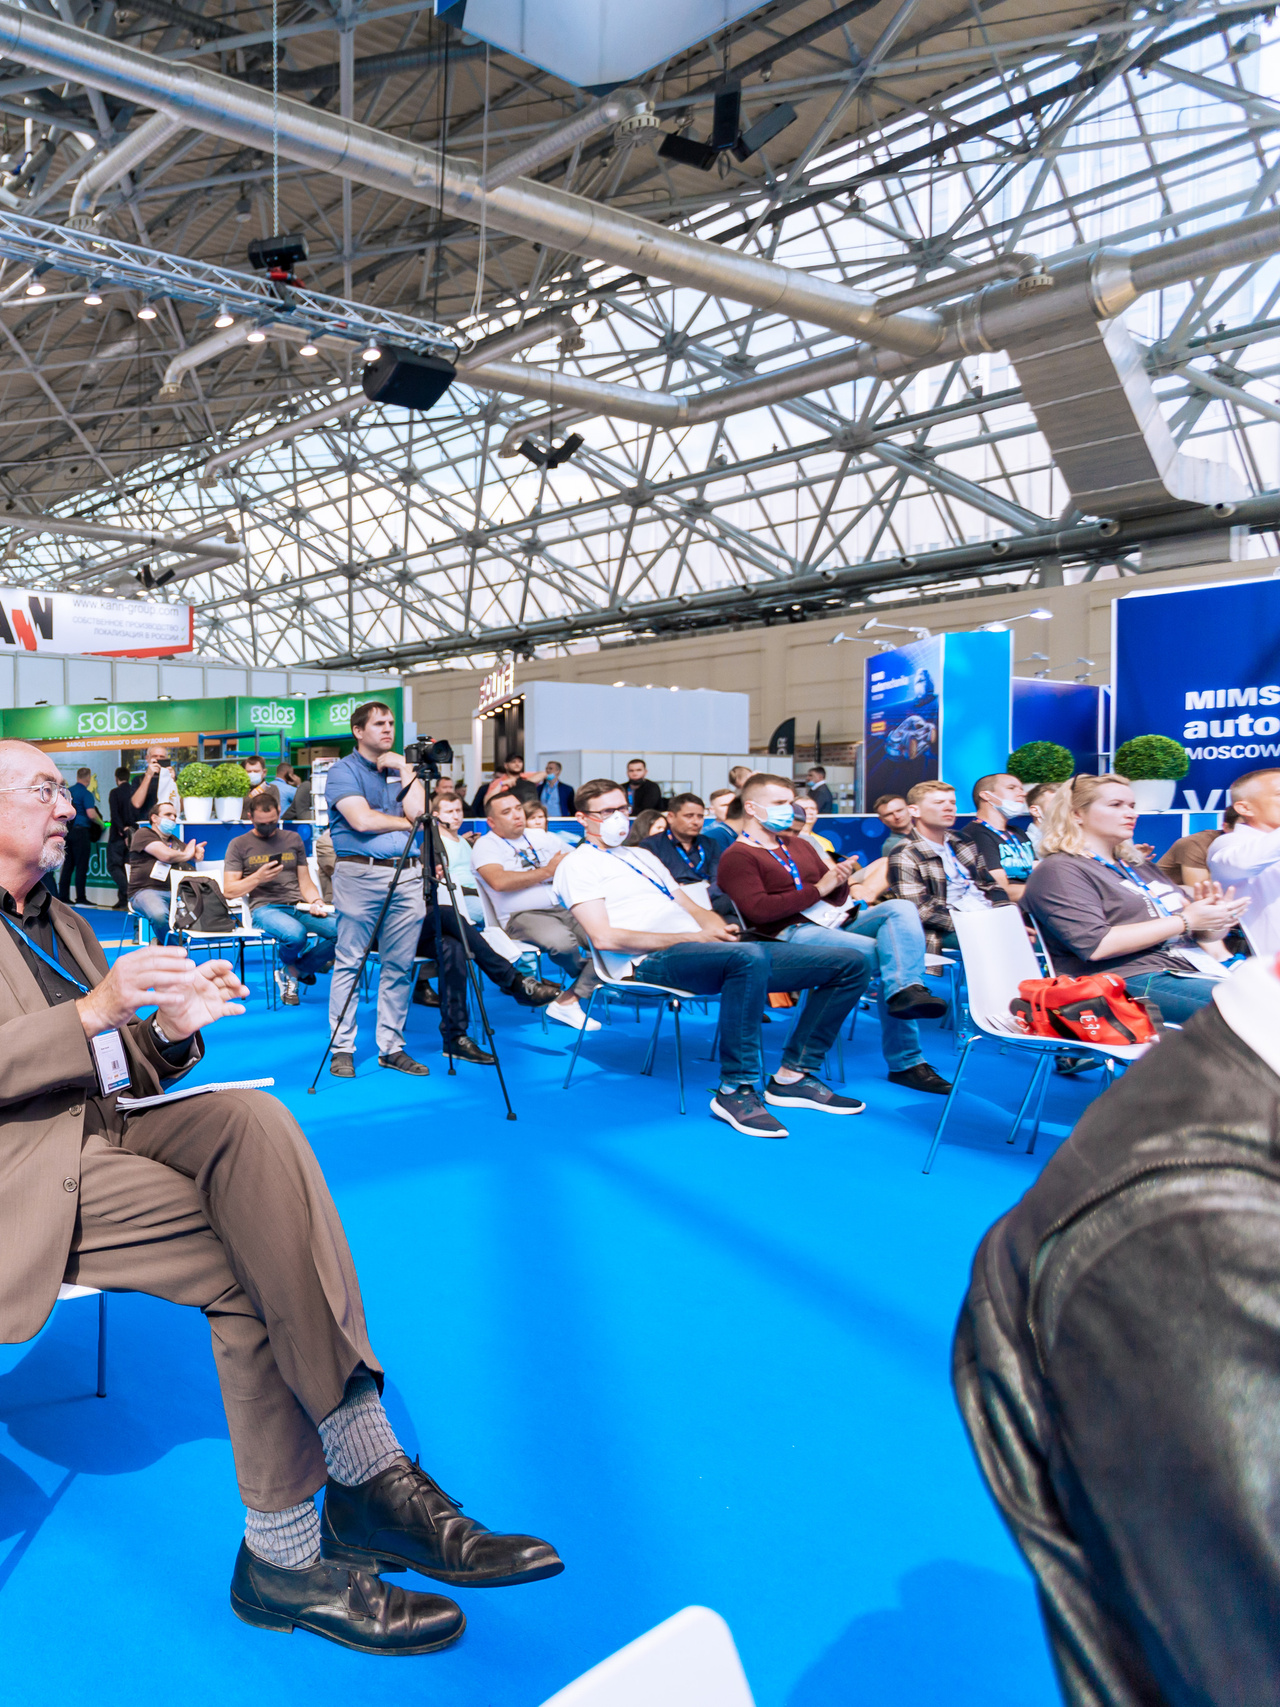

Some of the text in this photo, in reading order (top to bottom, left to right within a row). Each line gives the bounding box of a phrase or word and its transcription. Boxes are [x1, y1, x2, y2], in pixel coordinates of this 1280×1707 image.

[72, 599, 180, 616] www.kann-group.com
[72, 616, 179, 632] СОБСТВЕННОЕ ПРОИЗВОДСТВО
[94, 628, 144, 639] ЛОКАЛИЗАЦИЯ
[151, 633, 179, 641] РОССИИ
[1185, 685, 1280, 711] MIMS
[78, 706, 147, 733] solos
[250, 702, 296, 724] solos
[329, 697, 373, 722] sol
[1183, 713, 1280, 739] auto
[86, 738, 130, 747] СТЕЛЛАЖНОГО
[130, 737, 180, 745] ОБОРУДОВАНИЯ
